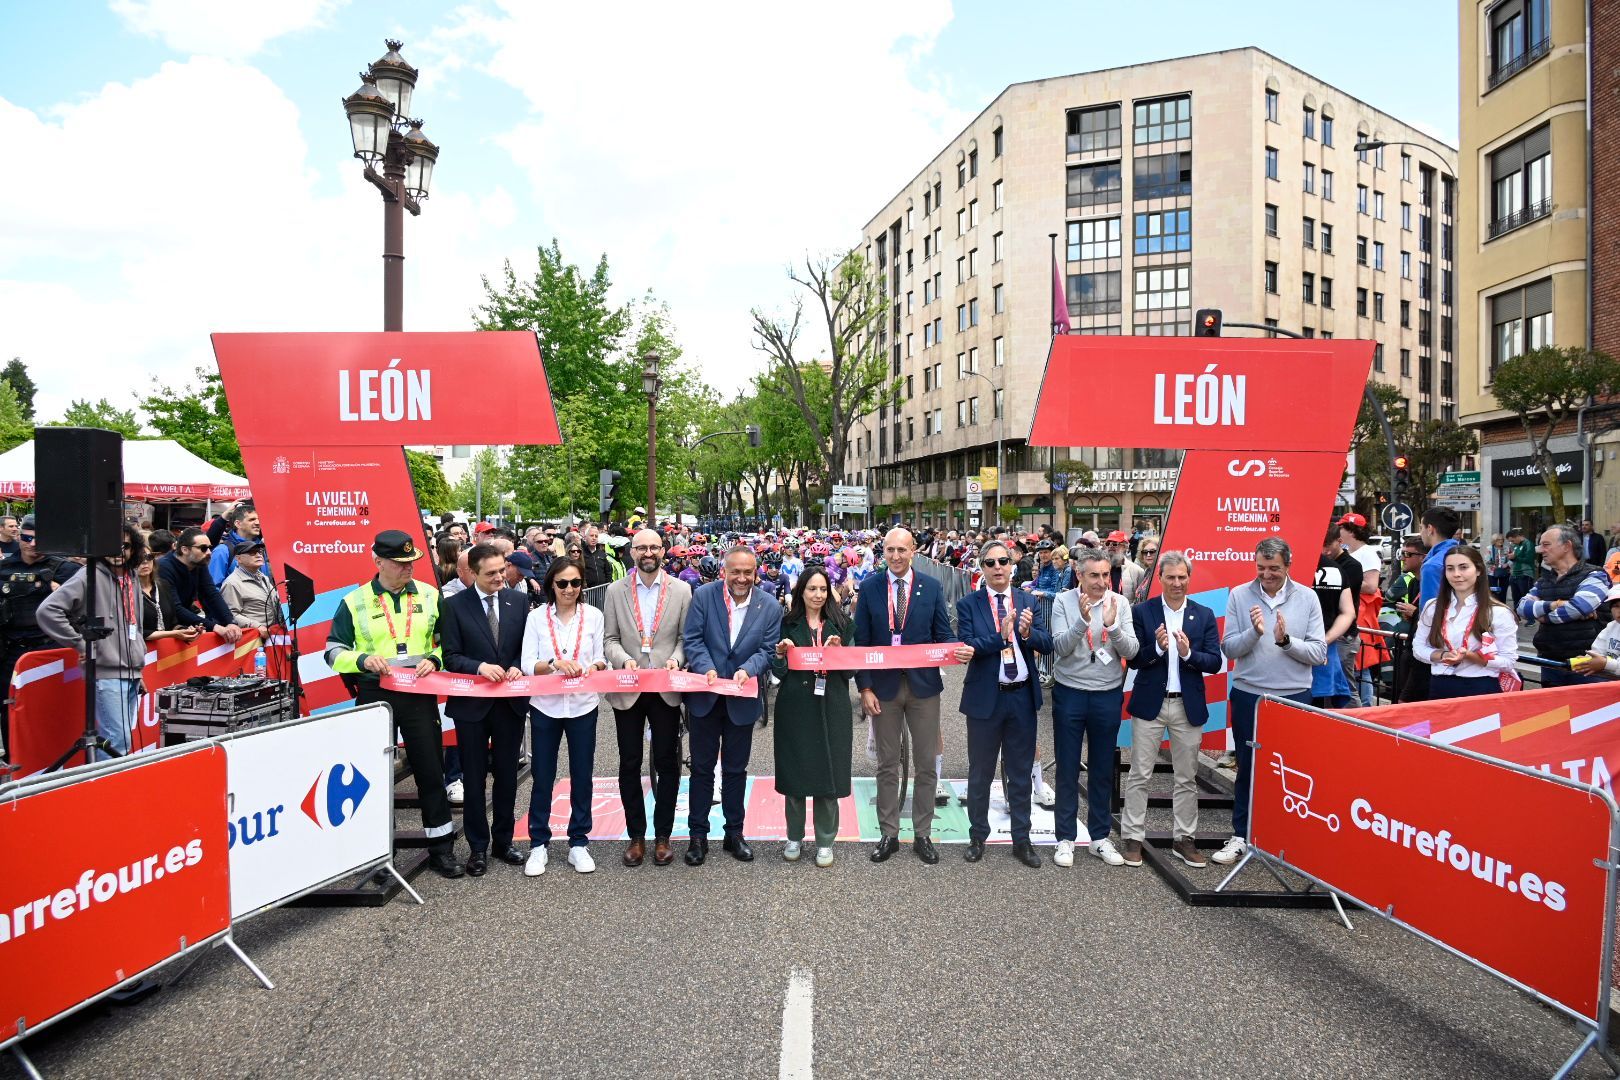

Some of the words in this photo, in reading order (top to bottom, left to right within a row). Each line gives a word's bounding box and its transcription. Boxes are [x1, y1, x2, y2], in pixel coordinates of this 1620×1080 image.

[339, 358, 432, 421] LEÓN
[1153, 363, 1246, 426] LEÓN
[1093, 470, 1177, 480] NSTRUCCIONE
[1502, 469, 1525, 478] VIAJES
[145, 485, 158, 493] LA
[160, 485, 191, 493] VUELTA
[1143, 479, 1175, 491] NUÑE
[234, 487, 252, 497] OFICIA
[305, 491, 320, 506] LA
[322, 491, 369, 506] VUELTA
[1217, 497, 1232, 512] LA
[1233, 497, 1280, 512] VUELTA
[317, 506, 357, 517] FEMENINA
[359, 506, 369, 516] 26
[1227, 513, 1268, 523] FEMENINA
[1270, 513, 1280, 523] 26
[292, 540, 366, 554] Carrefour
[1184, 547, 1256, 561] Carrefour
[865, 651, 884, 664] LEÓN
[1350, 797, 1567, 912] Carrefour.es
[0, 837, 203, 944] arrefour.es
